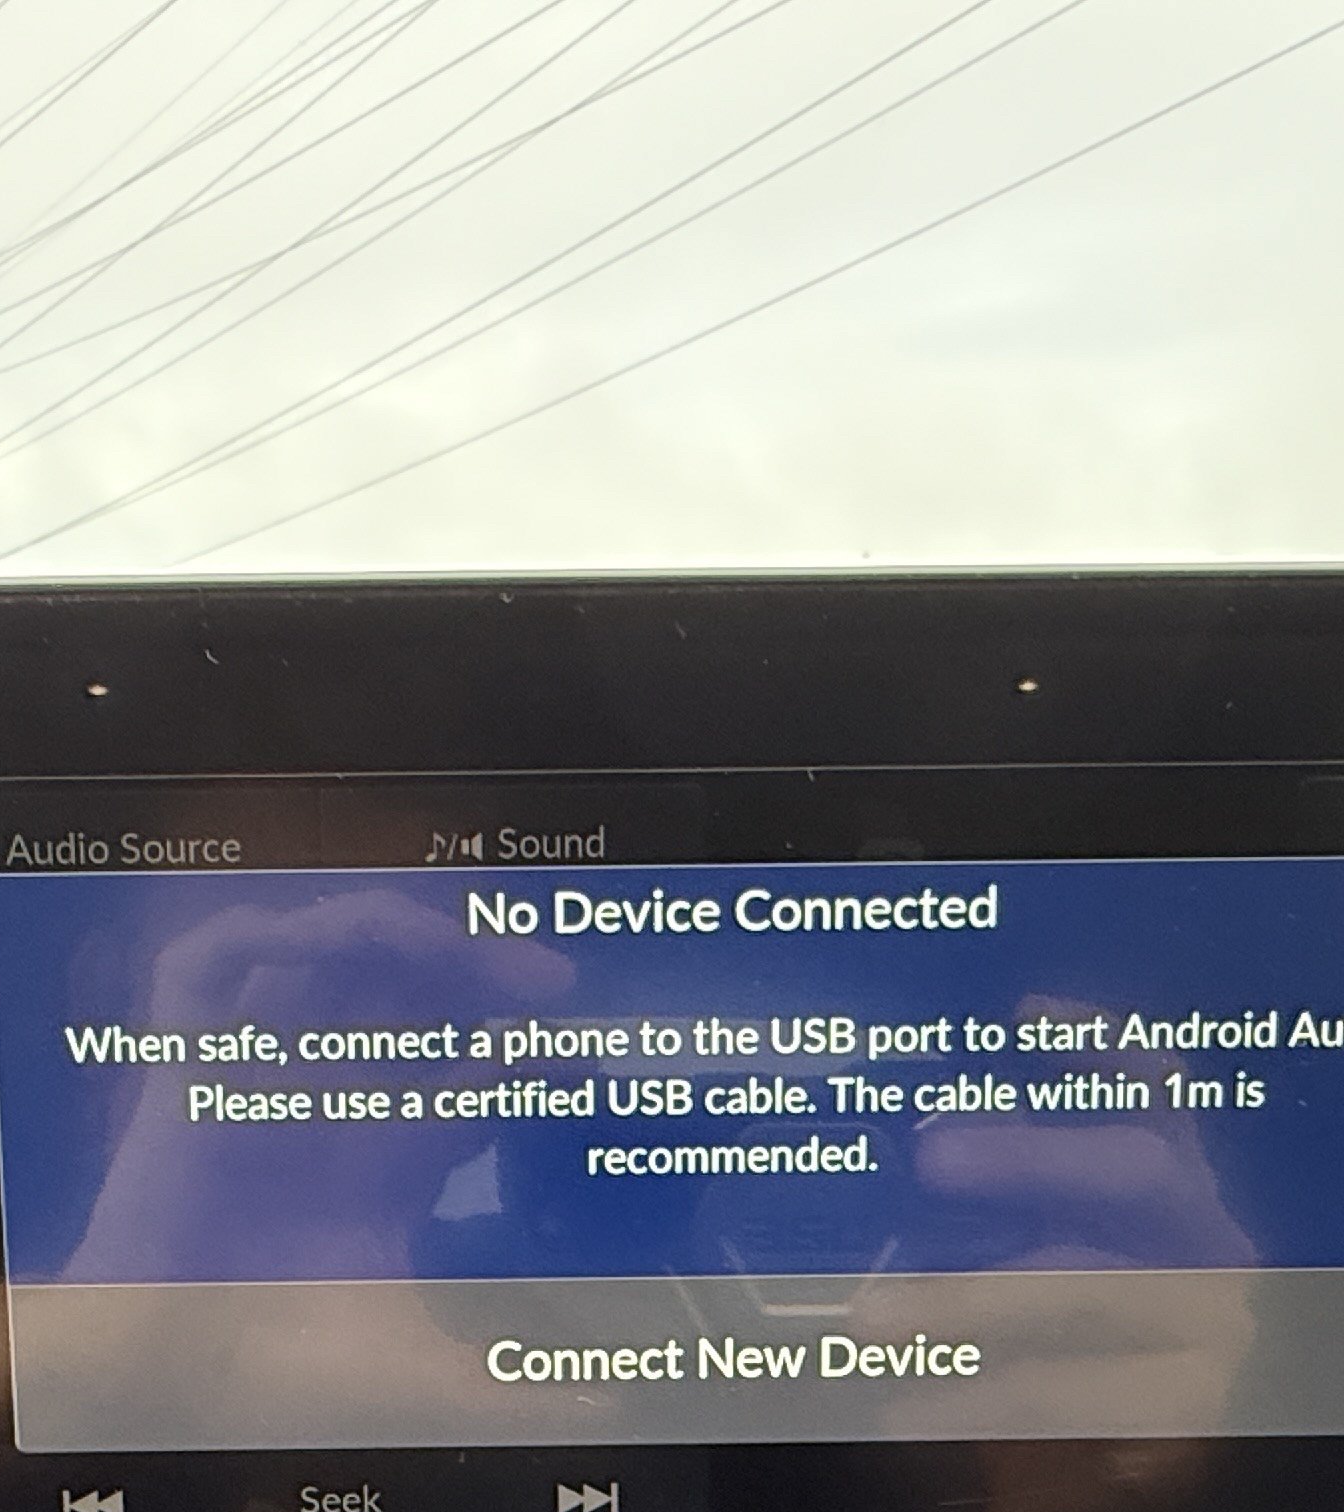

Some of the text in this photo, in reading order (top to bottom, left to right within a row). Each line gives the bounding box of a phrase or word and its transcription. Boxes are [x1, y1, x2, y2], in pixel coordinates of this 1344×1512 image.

[6, 834, 241, 866] Audio Source
[498, 825, 605, 860] Sound
[468, 884, 998, 936] No Device Connected
[64, 1025, 186, 1064] When
[198, 1024, 288, 1066] safe,
[298, 1023, 460, 1061] connect
[470, 1030, 492, 1058] a
[504, 1020, 630, 1066] phone
[639, 1022, 682, 1056] to
[692, 1019, 760, 1056] the
[770, 1018, 856, 1054] USB
[868, 1019, 953, 1061] port
[964, 1018, 1006, 1051] to
[1016, 1015, 1109, 1051] start
[1117, 1010, 1278, 1050] Android
[189, 1072, 1266, 1122] Please use a certified USB cable. The cable within 1m is
[588, 1136, 878, 1176] recommended.
[487, 1334, 982, 1382] Connect New Device
